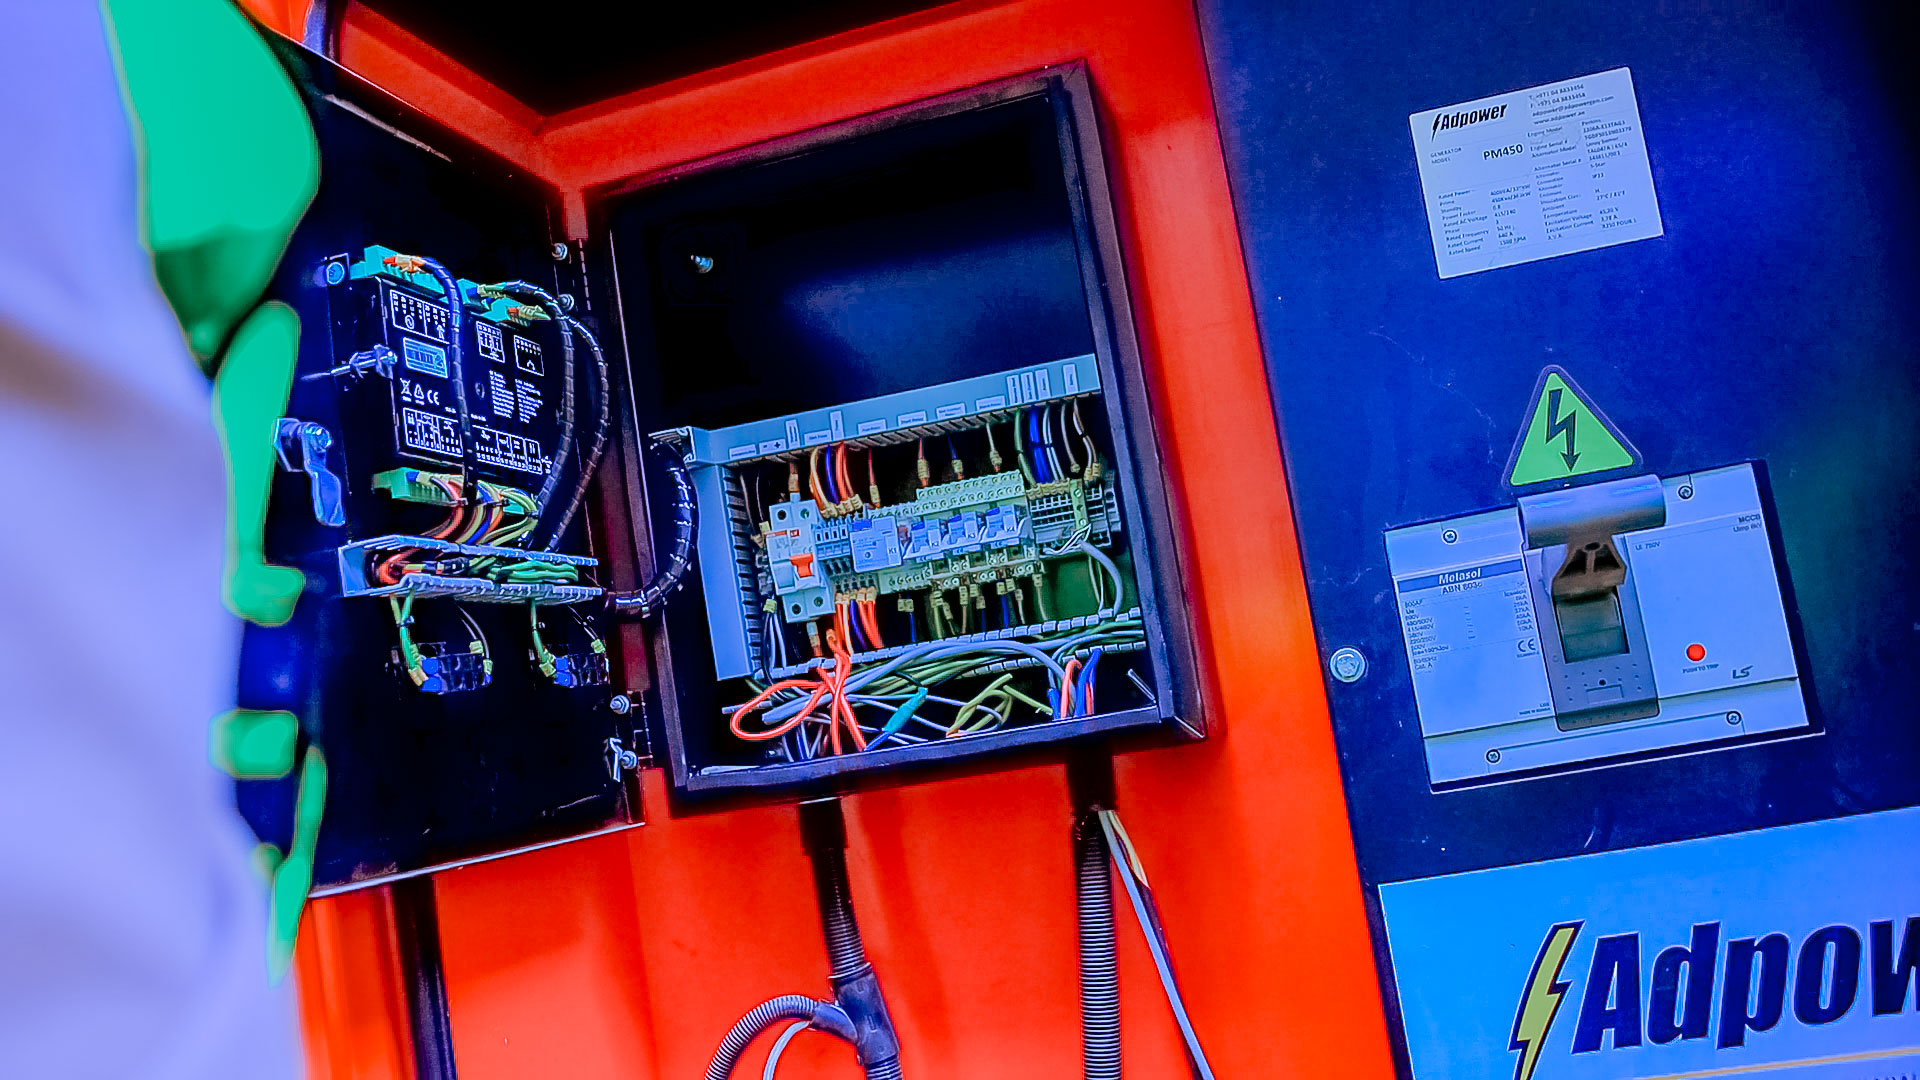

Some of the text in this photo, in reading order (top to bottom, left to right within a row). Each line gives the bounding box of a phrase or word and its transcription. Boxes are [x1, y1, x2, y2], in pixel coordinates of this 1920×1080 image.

[1440, 104, 1508, 130] Adpower
[1430, 147, 1461, 157] GENERATOR
[1483, 144, 1523, 160] PM450
[1439, 568, 1481, 584] Metasol
[1442, 584, 1461, 593] ABN
